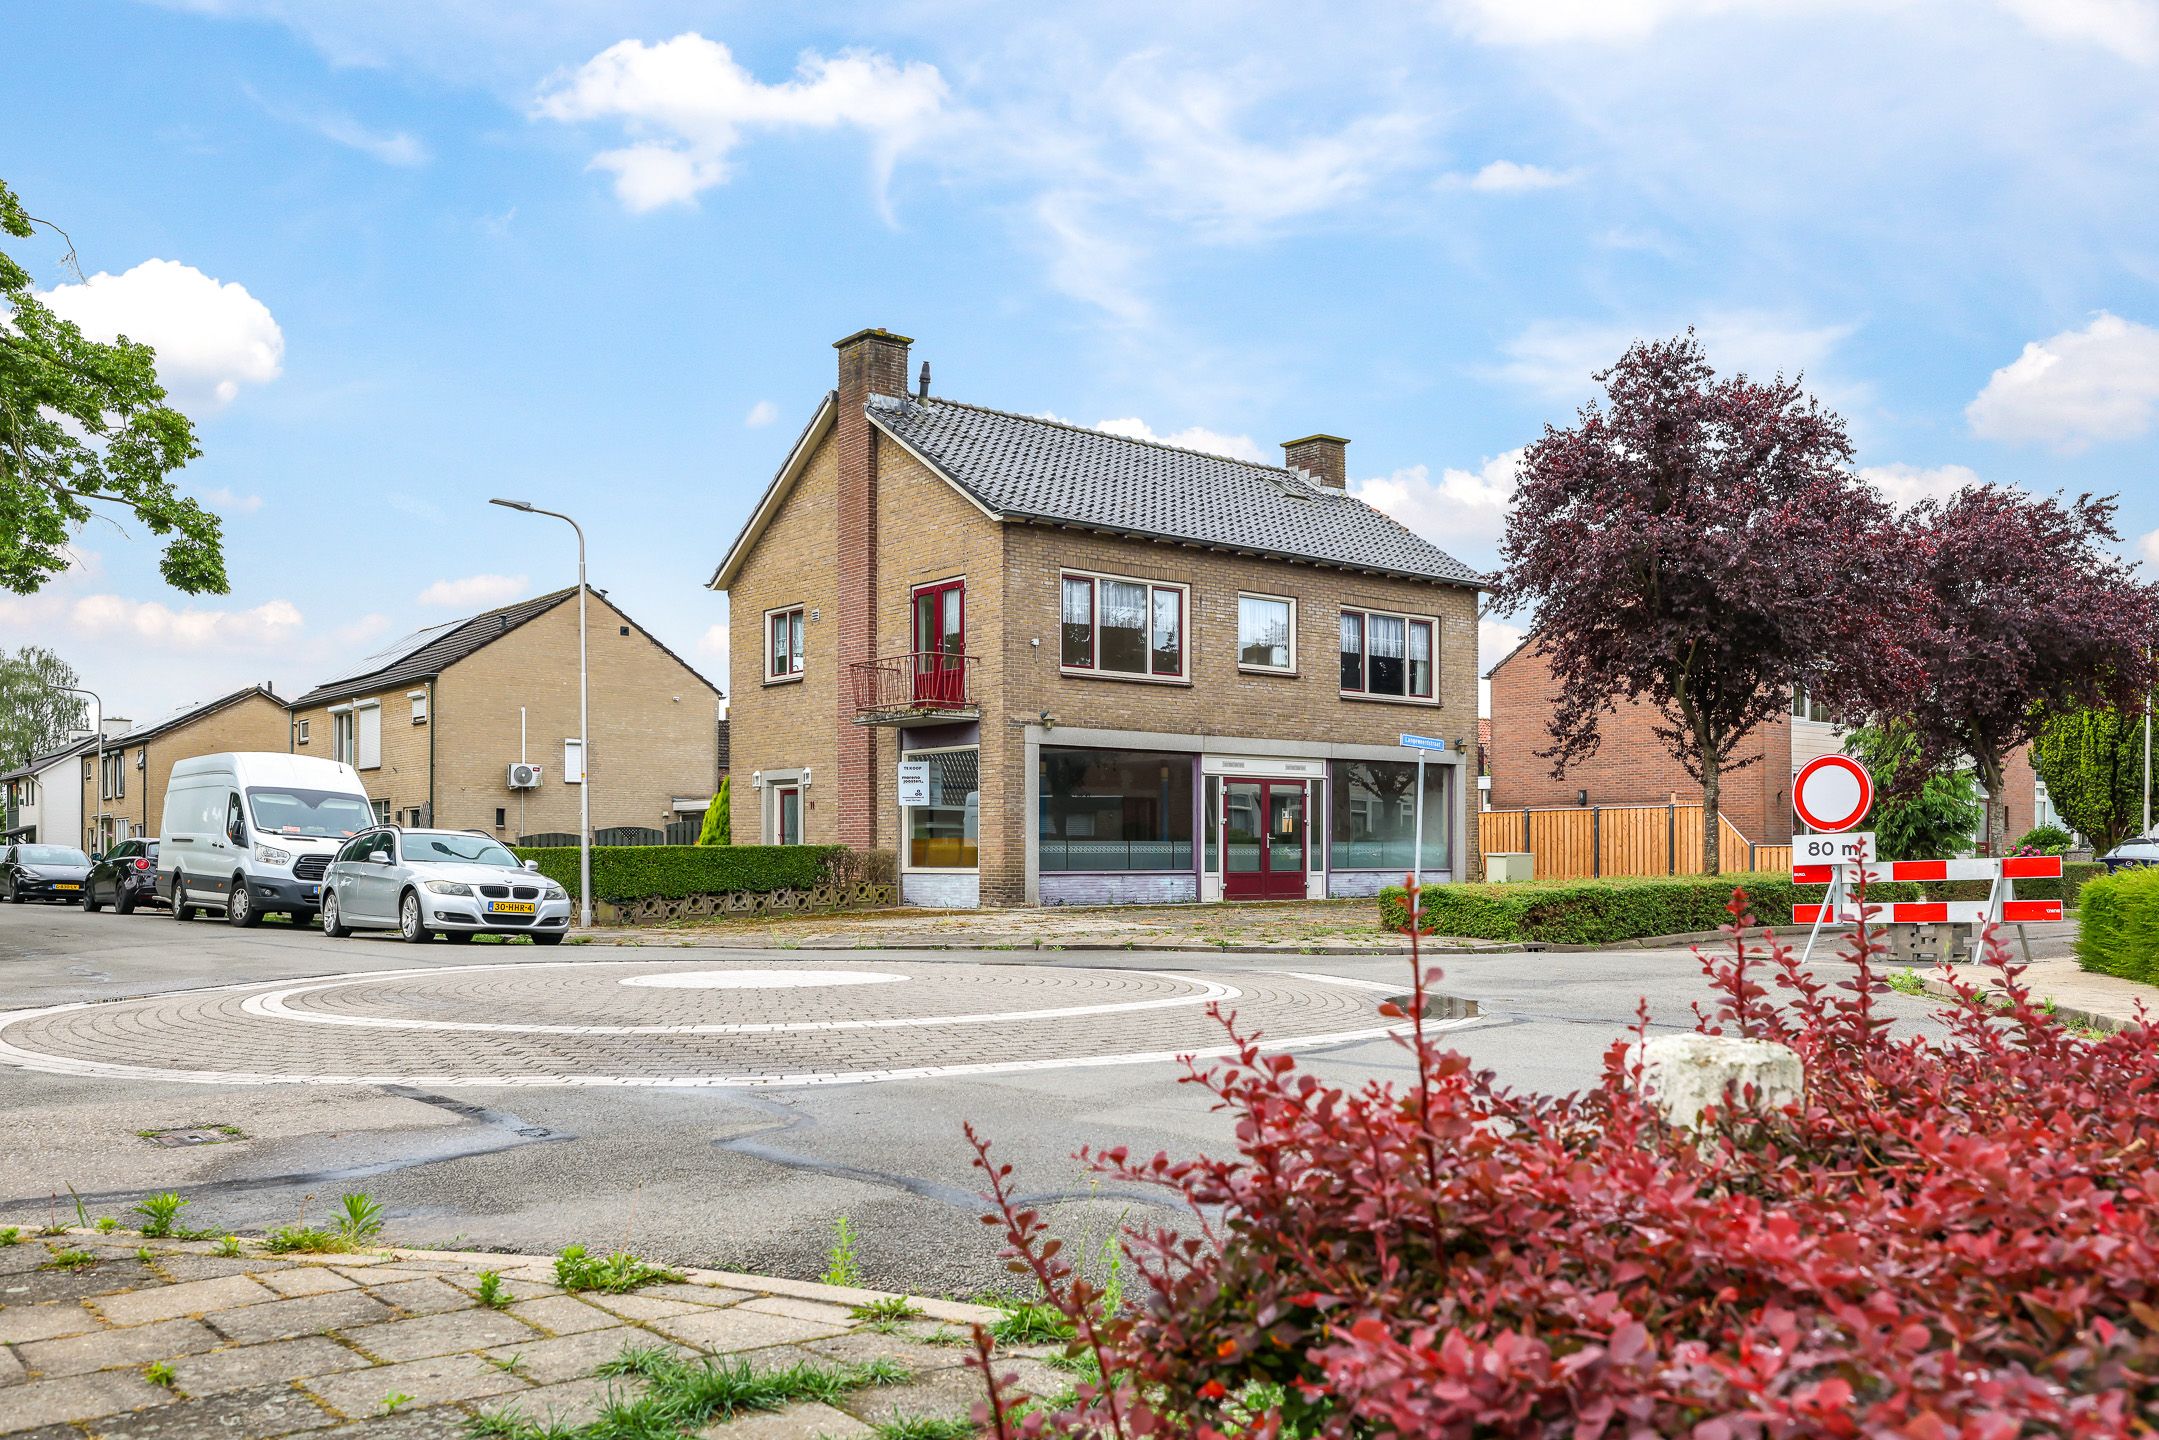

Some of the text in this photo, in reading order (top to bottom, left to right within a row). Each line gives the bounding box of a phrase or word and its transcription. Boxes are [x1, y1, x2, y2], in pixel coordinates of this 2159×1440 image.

[1808, 841, 1858, 856] 80 m
[494, 903, 533, 912] 30-HHR-4
